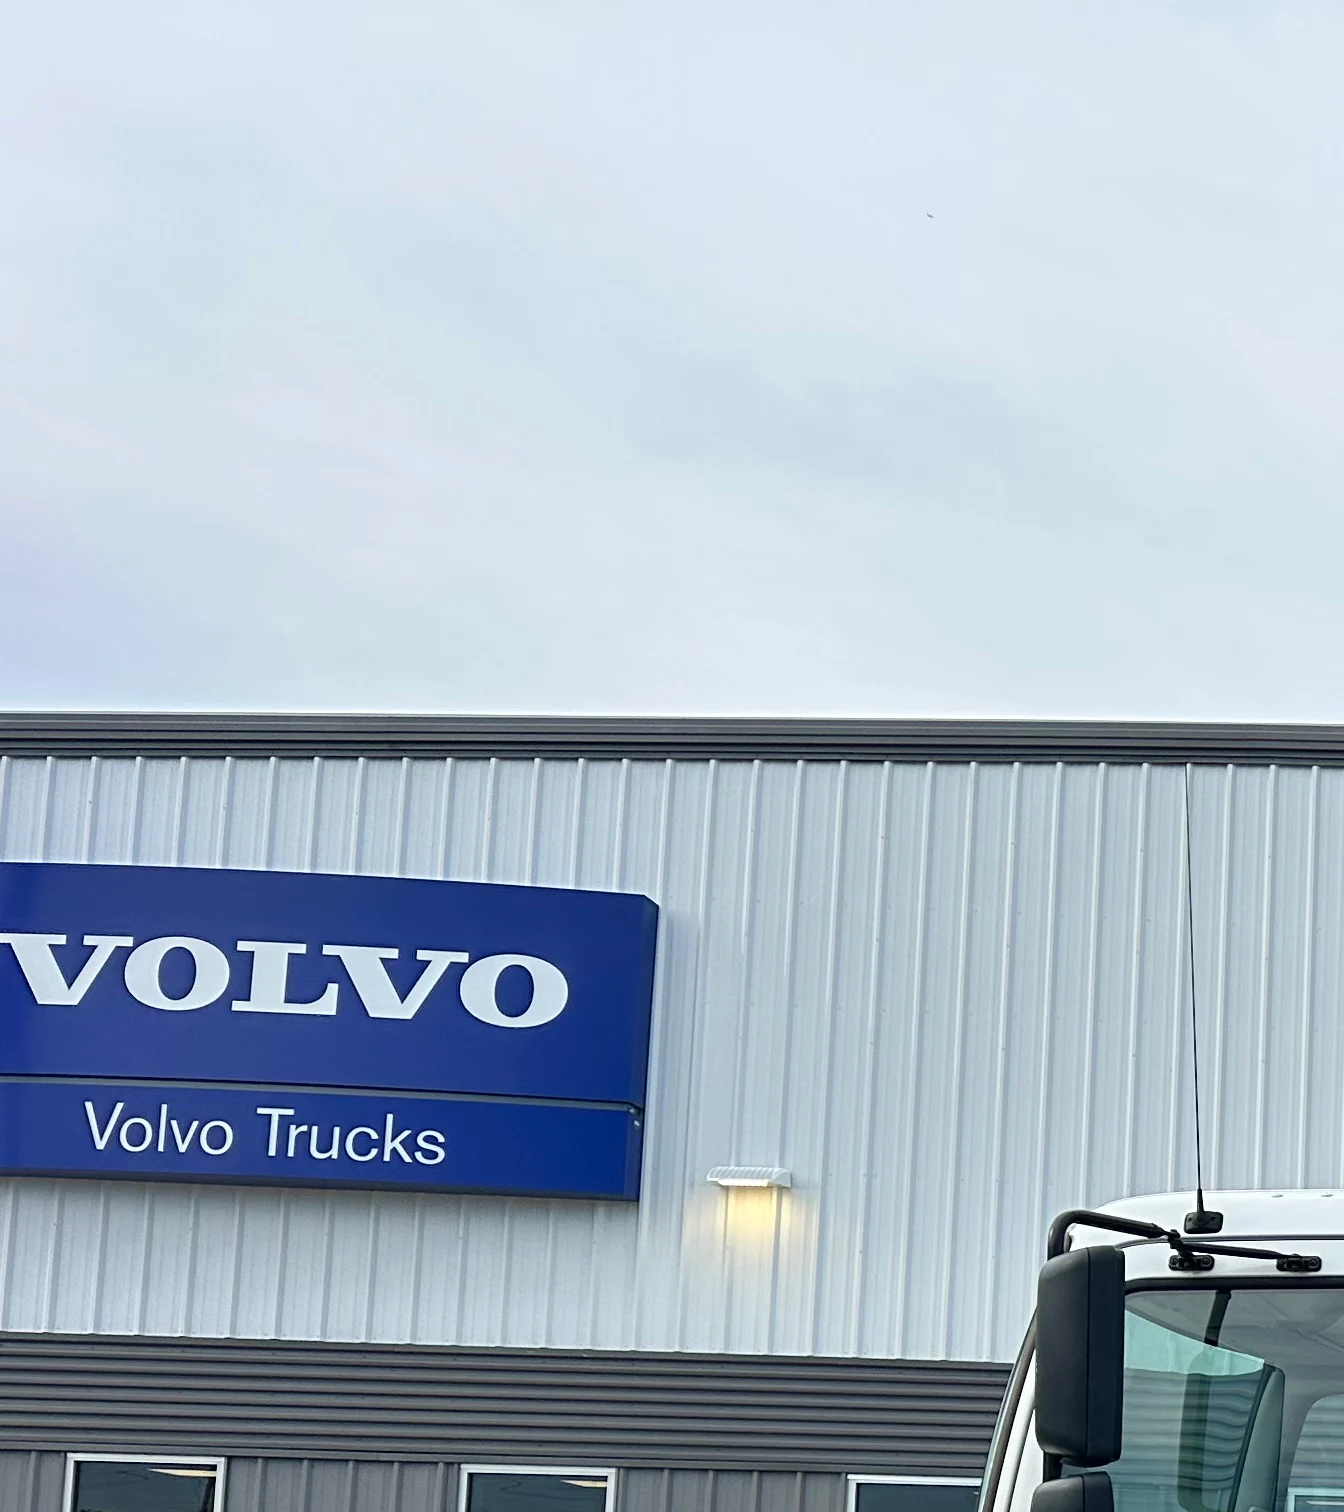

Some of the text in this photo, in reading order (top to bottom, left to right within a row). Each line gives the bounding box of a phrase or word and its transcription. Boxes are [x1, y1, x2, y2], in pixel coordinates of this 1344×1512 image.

[0, 933, 568, 1028] VOLVO
[85, 1101, 446, 1165] Volvo Trucks
